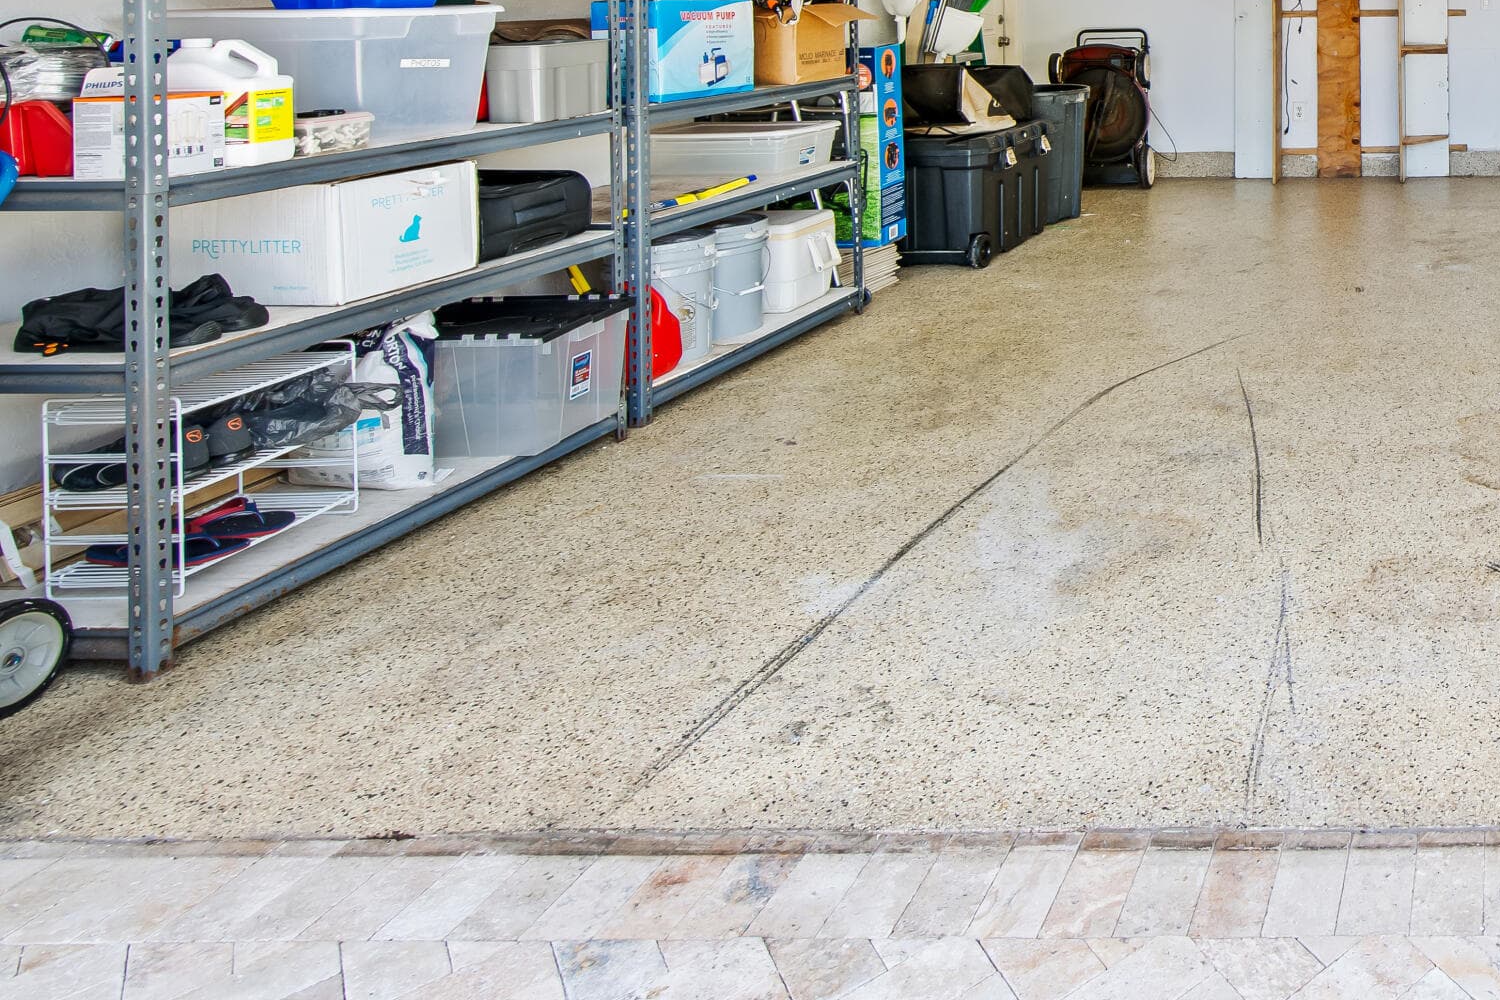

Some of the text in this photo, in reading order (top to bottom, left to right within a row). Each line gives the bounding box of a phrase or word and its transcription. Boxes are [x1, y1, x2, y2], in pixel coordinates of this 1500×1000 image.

[680, 11, 736, 22] VACUUM PUMP
[85, 80, 123, 90] PHILIPS
[192, 239, 301, 260] PRETTYLITTER
[383, 336, 407, 371] ORTON
